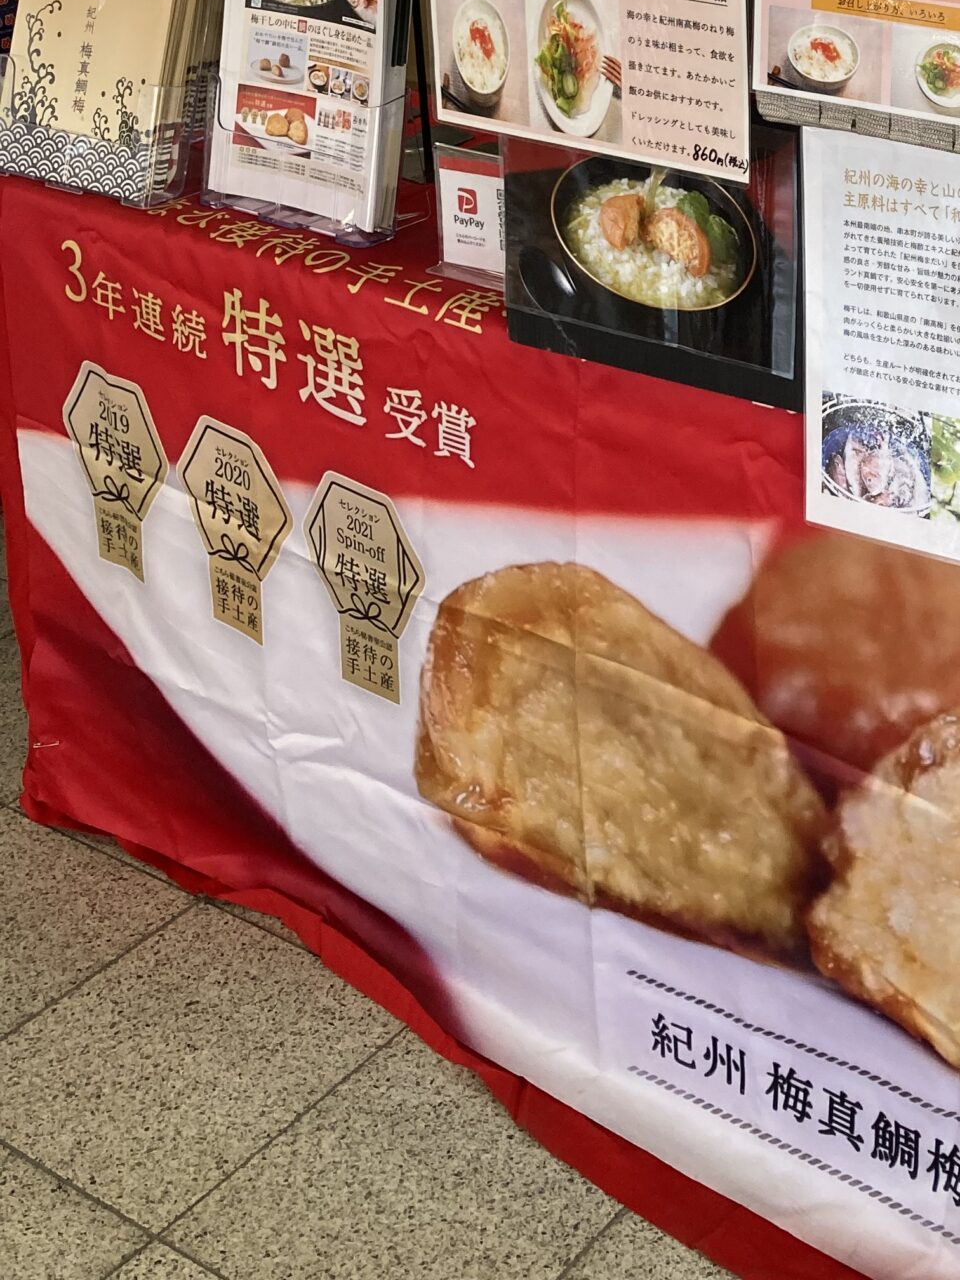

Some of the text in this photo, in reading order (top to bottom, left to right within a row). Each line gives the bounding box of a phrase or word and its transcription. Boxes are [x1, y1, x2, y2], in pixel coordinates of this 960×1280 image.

[627, 35, 735, 62] のうま味が相まって、食欲を
[628, 85, 724, 113] 飯のお供におすすめです。
[630, 111, 736, 140] ドレッシングとしても美味し
[631, 136, 692, 157] くいただけます。
[454, 214, 485, 230] PayPay
[60, 239, 478, 470] 3年連続 特選 受賞
[98, 401, 131, 434] 2019
[89, 422, 145, 484] 特選
[214, 458, 251, 492] 2020
[205, 480, 262, 543] 特選
[338, 498, 381, 524] セレクション
[346, 514, 374, 542] 2021
[336, 527, 386, 563] Spin-off
[216, 577, 259, 611] 接待の
[335, 552, 391, 605] 特選
[217, 597, 259, 633] 手土産
[346, 636, 394, 671] 接待の
[346, 657, 395, 693] 手土産
[651, 1013, 748, 1095] 紀州
